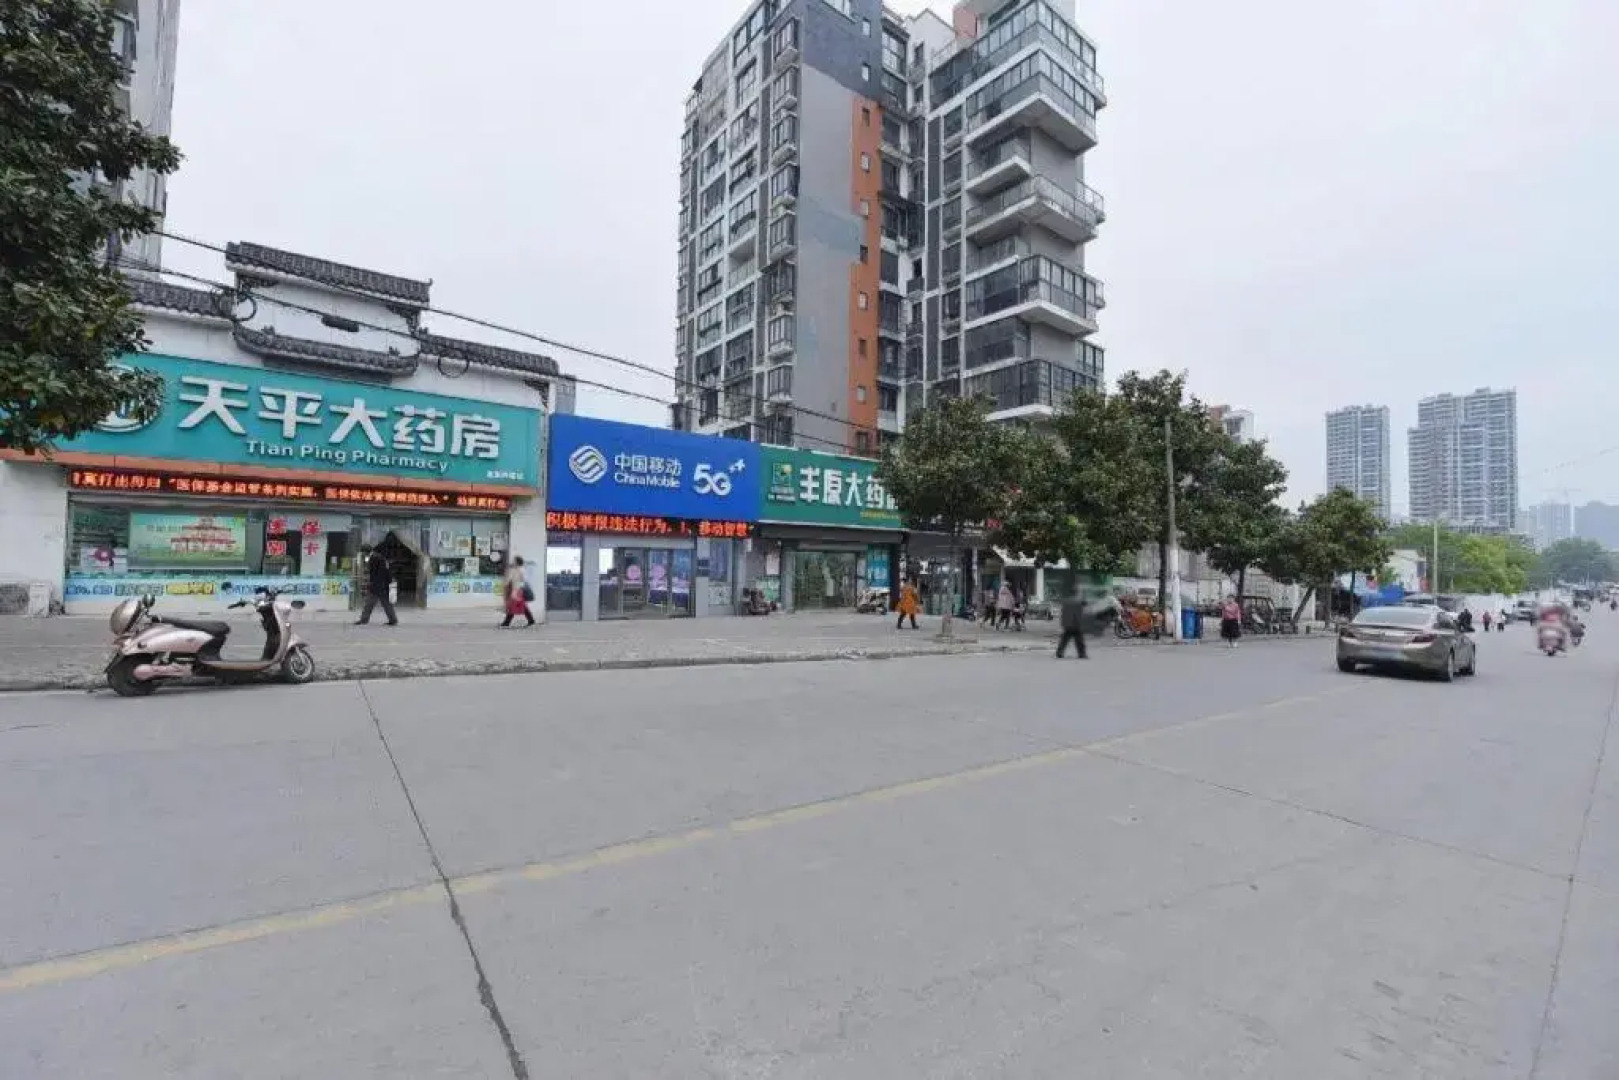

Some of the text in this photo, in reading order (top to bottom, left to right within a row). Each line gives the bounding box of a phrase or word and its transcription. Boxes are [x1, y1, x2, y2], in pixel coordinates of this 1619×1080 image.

[178, 376, 500, 458] 天平大药房
[247, 440, 448, 472] Tian Ping Pharmacy
[615, 453, 682, 476] 中国移动
